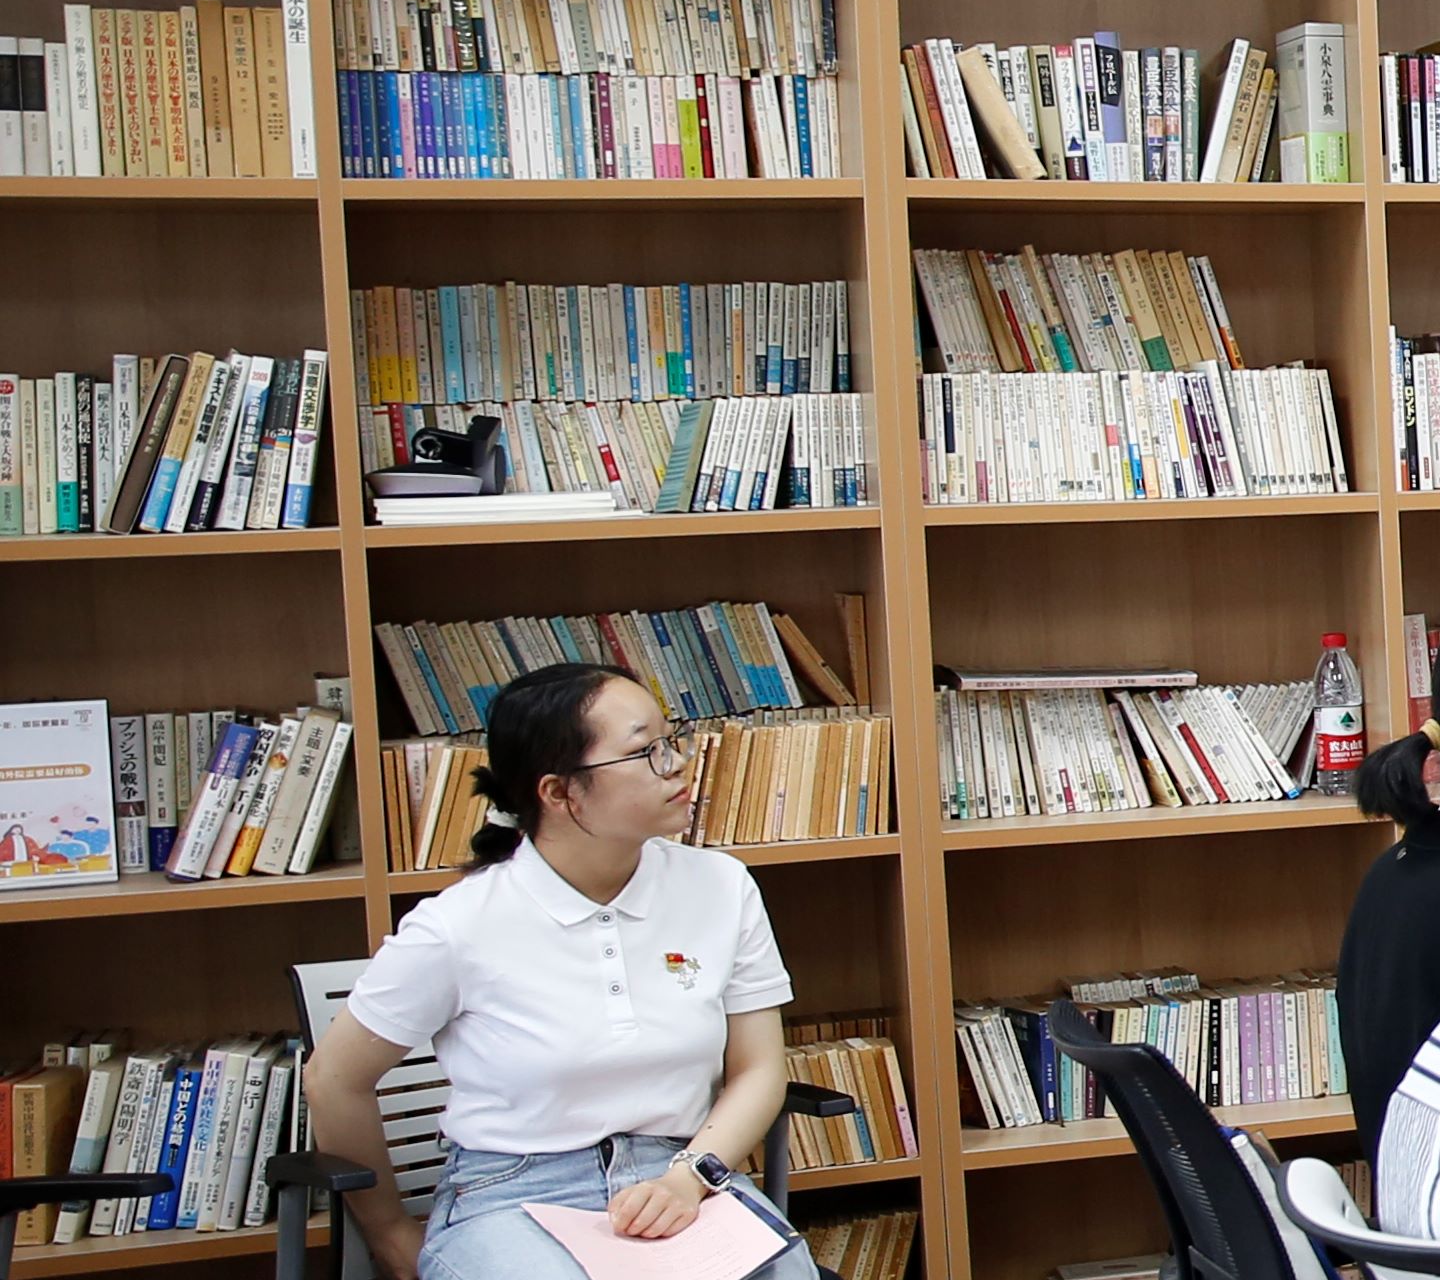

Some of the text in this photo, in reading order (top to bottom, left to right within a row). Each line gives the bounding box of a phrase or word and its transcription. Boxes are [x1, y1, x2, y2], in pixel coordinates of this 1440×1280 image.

[101, 47, 114, 92] 日本の歴史
[123, 48, 136, 93] 日本の歴史
[145, 48, 158, 93] 日本の歴史
[167, 49, 181, 94] 日本の歴史
[61, 413, 76, 478] 日本をめぐって
[118, 720, 139, 801] ブッシュの戦争
